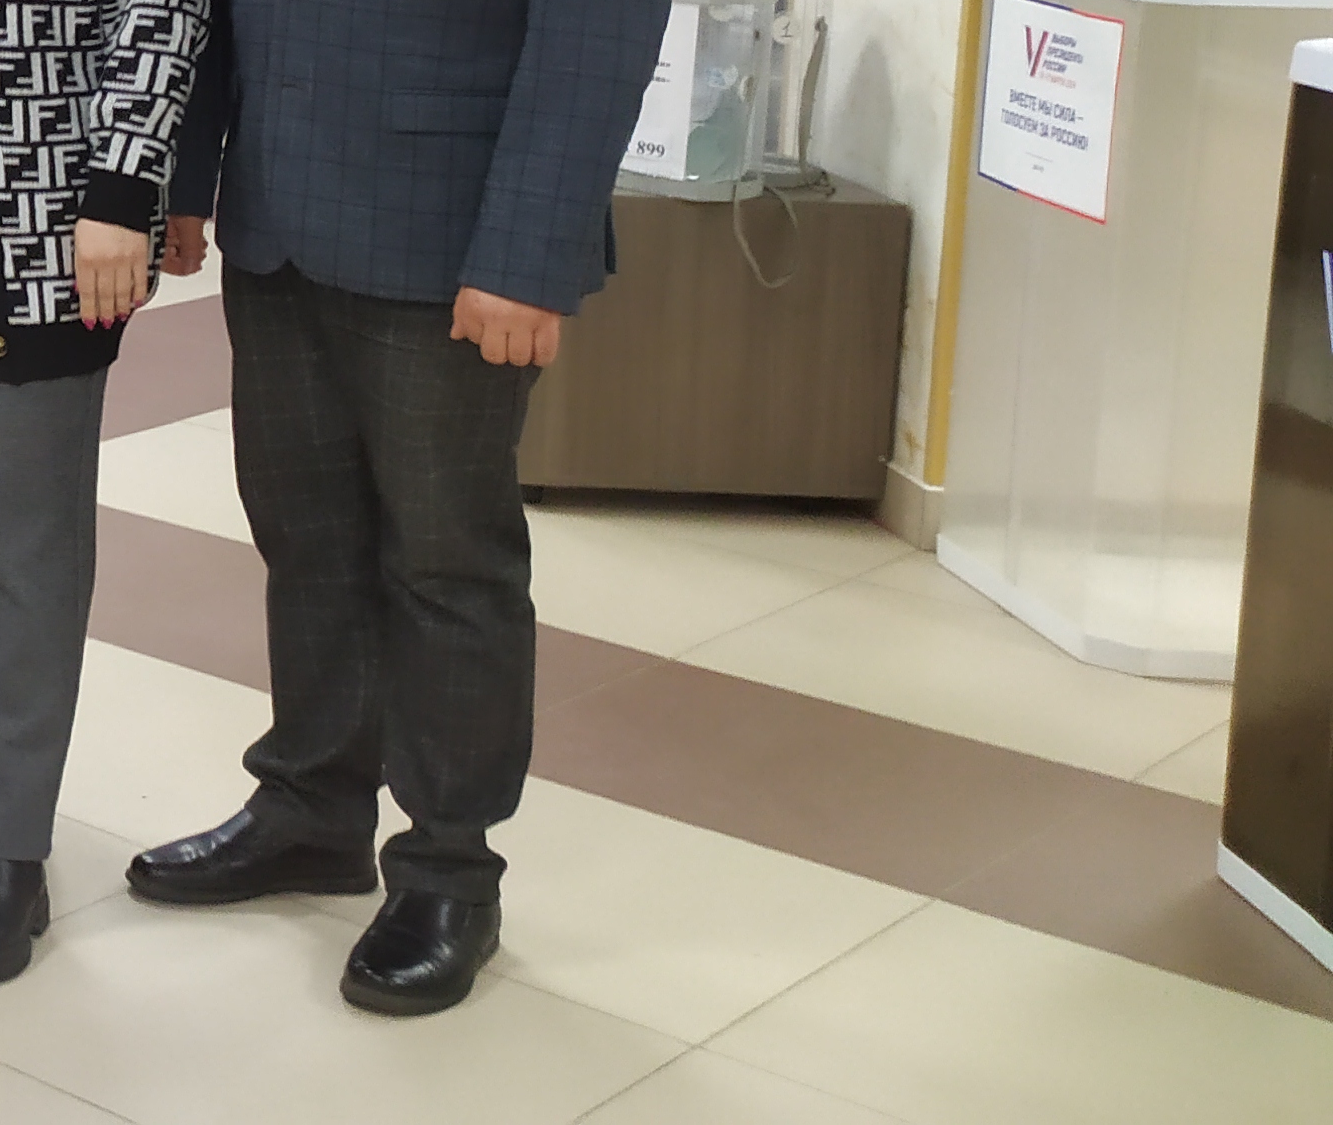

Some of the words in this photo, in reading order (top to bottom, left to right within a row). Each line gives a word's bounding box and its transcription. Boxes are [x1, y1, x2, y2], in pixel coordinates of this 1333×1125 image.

[1009, 88, 1037, 112] ВМЕСТЕ
[1038, 99, 1052, 116] МЫ
[1054, 103, 1076, 123] СИЛА
[1001, 108, 1039, 134] ГОЛОСУЕМ
[1040, 122, 1049, 137] ЗА
[1051, 125, 1088, 150] РОССИЮ!
[636, 140, 666, 158] 899
